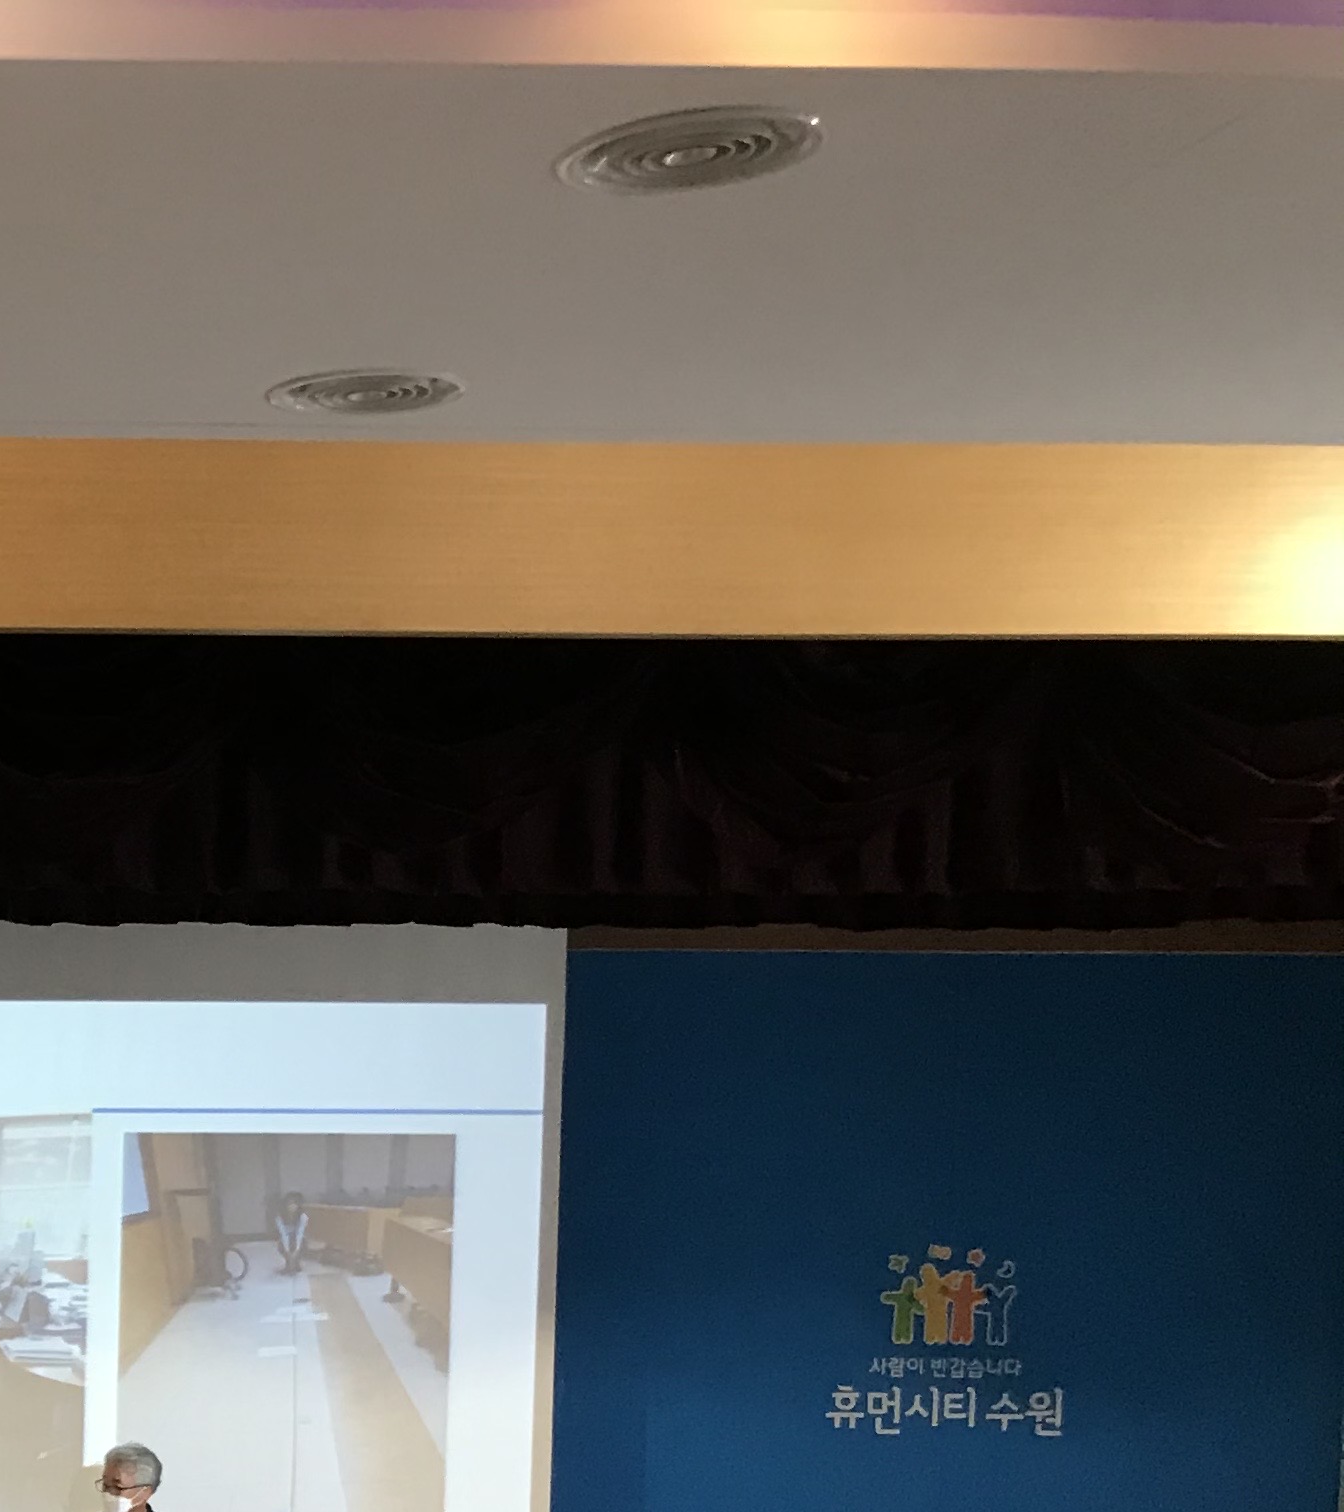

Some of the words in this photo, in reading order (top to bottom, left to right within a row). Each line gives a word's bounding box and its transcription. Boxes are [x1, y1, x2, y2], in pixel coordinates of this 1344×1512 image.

[868, 1356, 925, 1378] 사람이
[825, 1384, 976, 1435] 휴먼시티
[985, 1387, 1064, 1437] 수원
